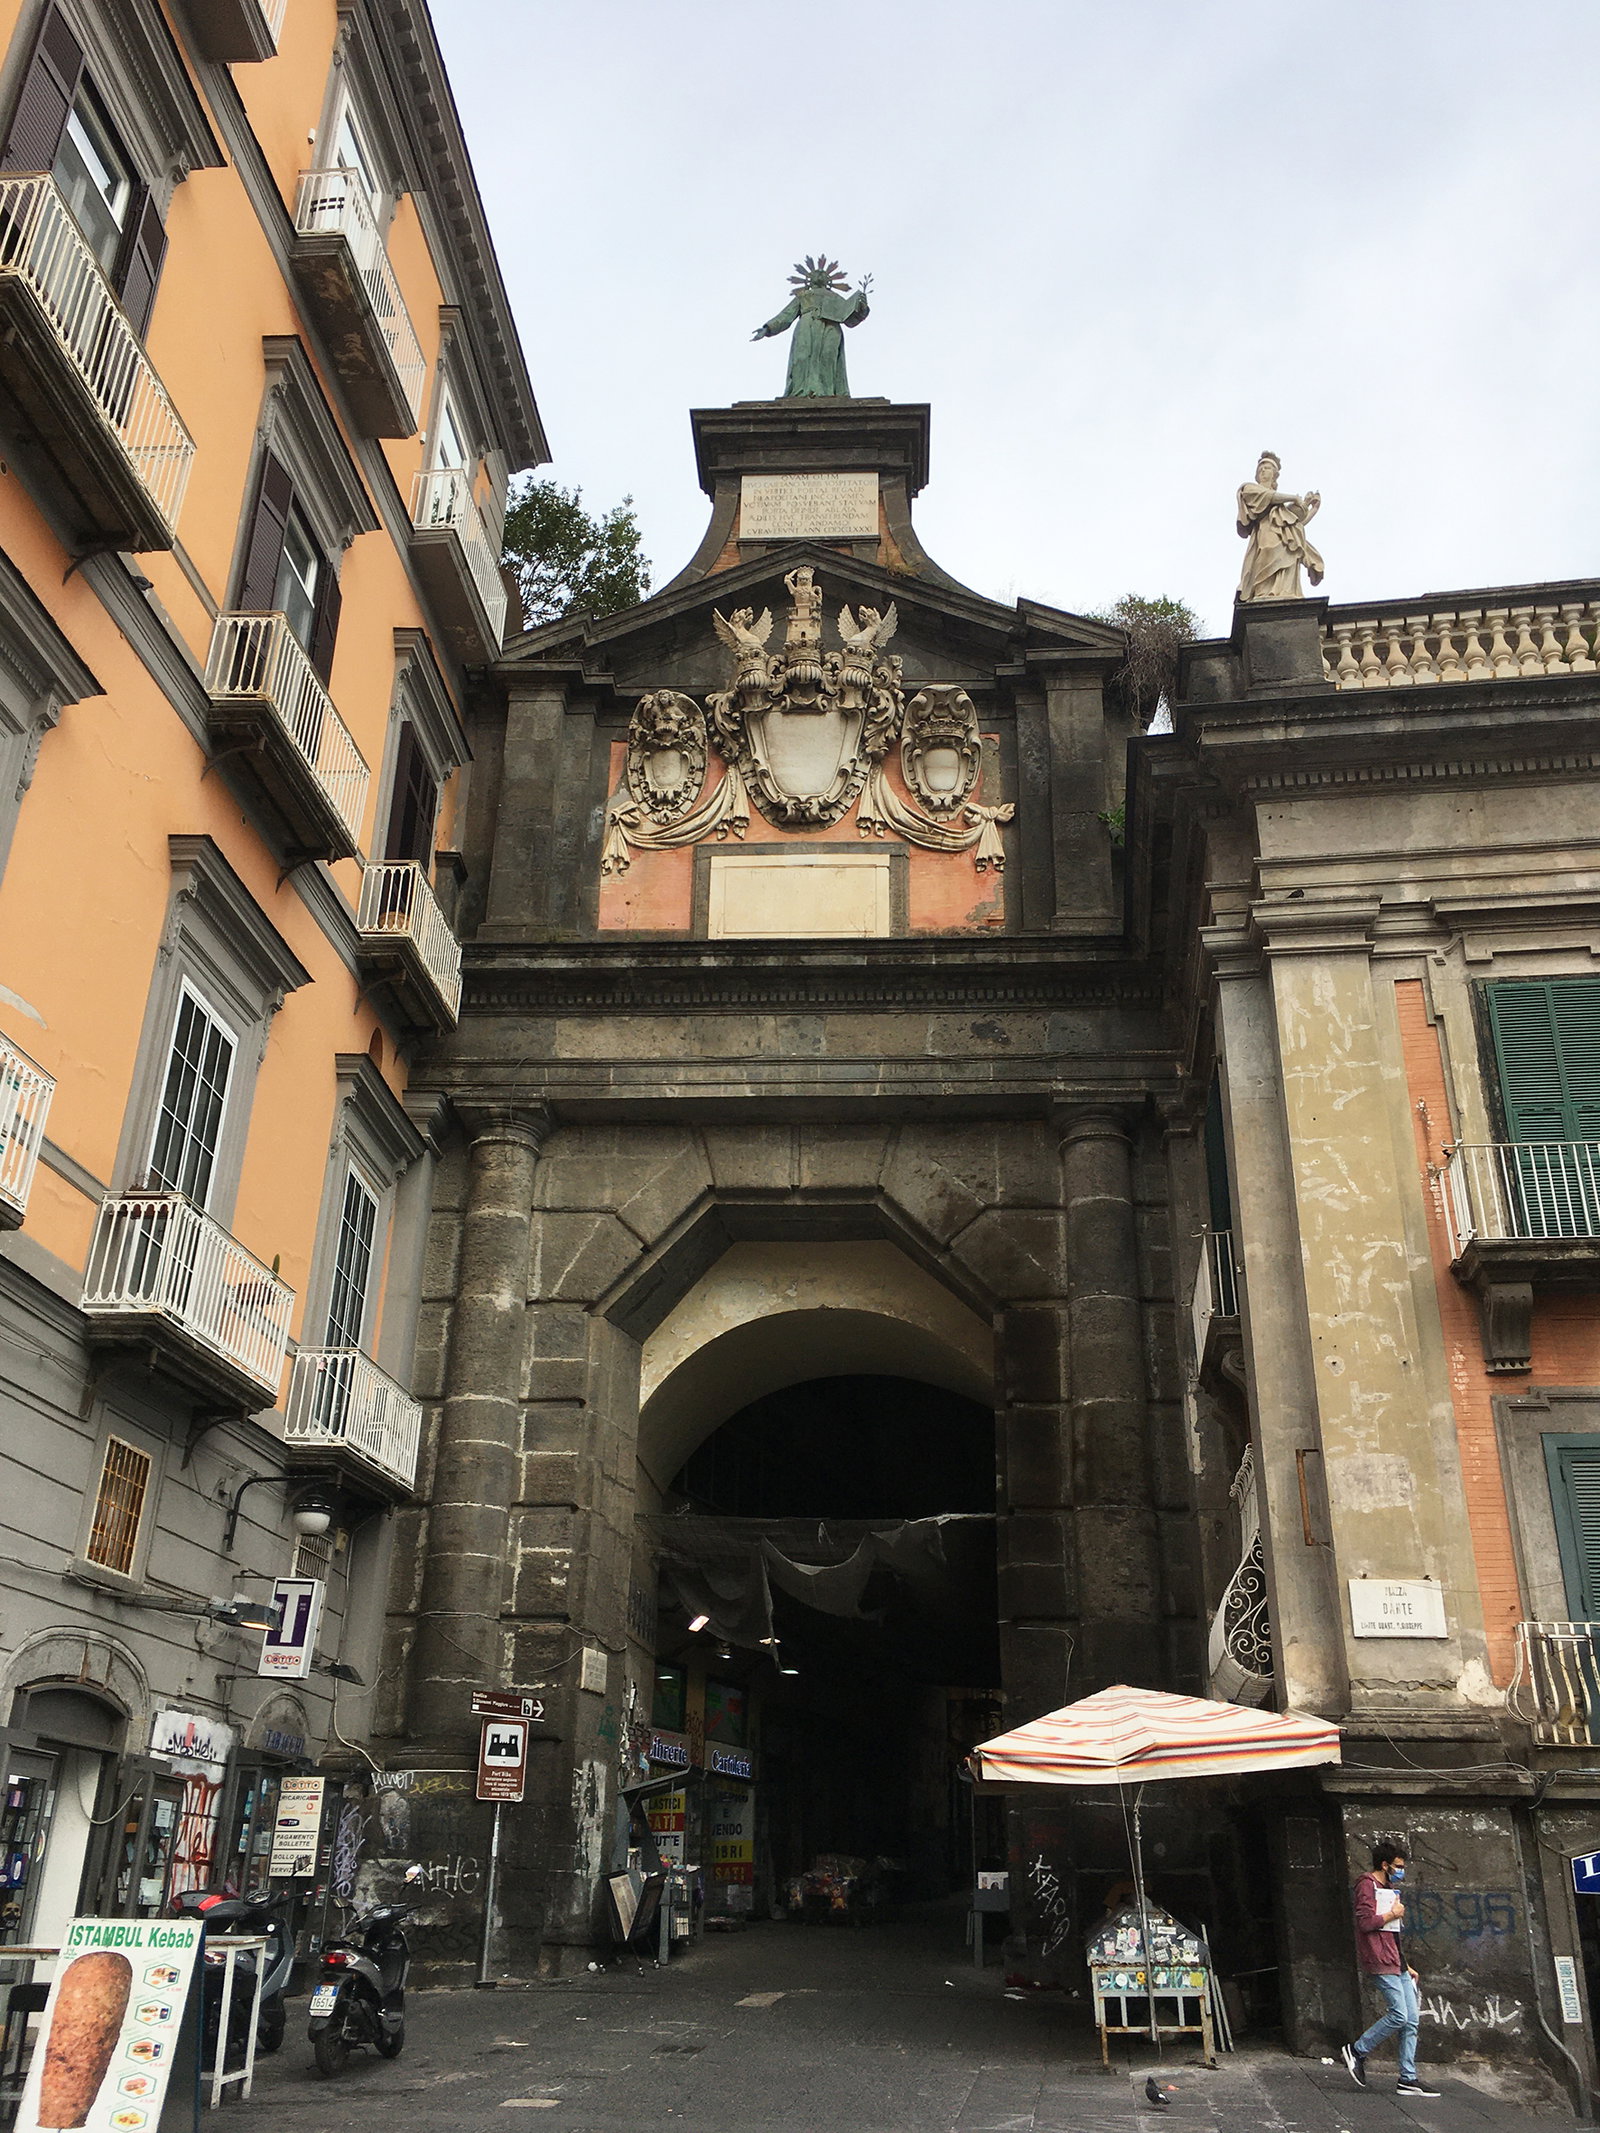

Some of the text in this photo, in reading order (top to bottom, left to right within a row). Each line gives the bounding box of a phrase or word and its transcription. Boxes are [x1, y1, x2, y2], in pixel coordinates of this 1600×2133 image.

[1382, 1602, 1414, 1615] DANTE
[263, 1654, 302, 1666] LOTTO
[283, 1780, 320, 1790] LOTTO
[67, 1925, 195, 1949] ISTAMBUL Kebab
